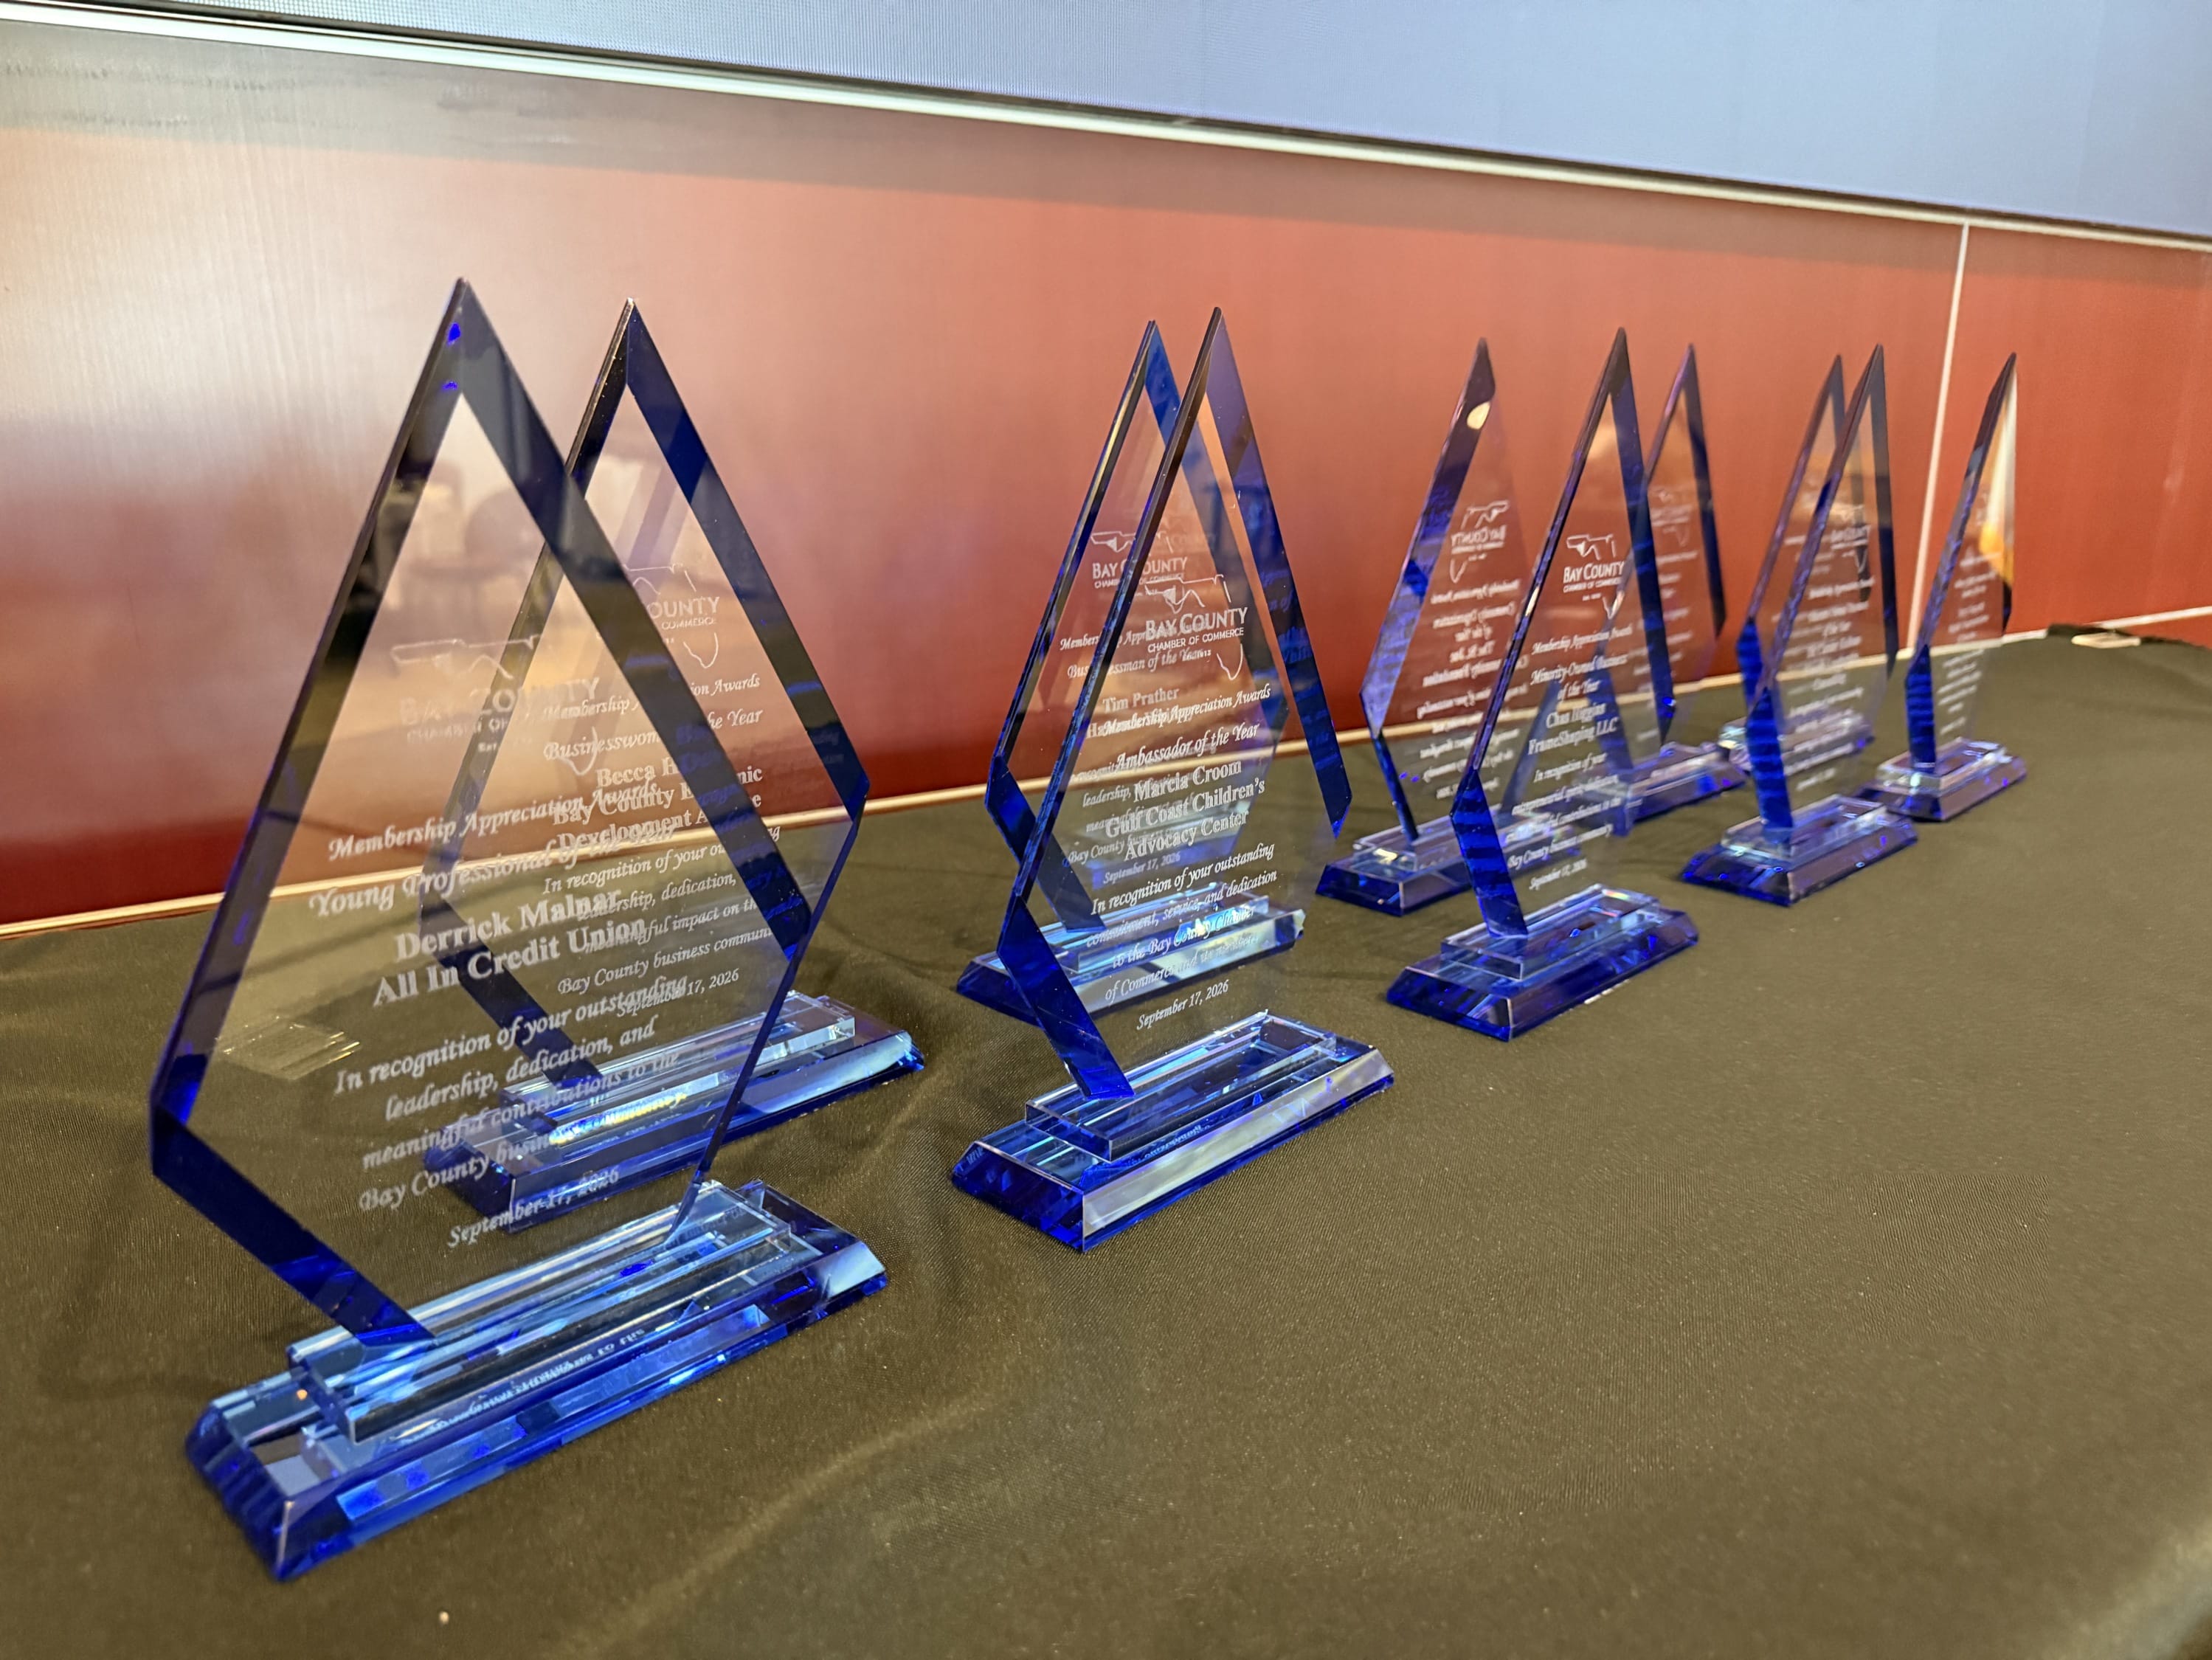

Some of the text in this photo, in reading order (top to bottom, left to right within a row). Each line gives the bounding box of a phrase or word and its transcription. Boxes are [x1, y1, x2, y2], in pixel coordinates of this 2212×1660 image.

[1092, 562, 1119, 579] BAY
[1563, 561, 1625, 584] BAY COUNTY
[646, 596, 720, 620] OUNTY
[1145, 618, 1178, 640] BAY
[1179, 607, 1248, 634] COUNTY
[1060, 631, 1122, 651] Membersp
[1147, 627, 1245, 653] CHAMBER OF COMMERCE
[1067, 658, 1146, 679] Busessman
[1147, 651, 1160, 672] of
[1161, 649, 1178, 665] the
[543, 695, 630, 720] Membership
[711, 674, 761, 696] Awards
[1102, 688, 1181, 713] Tim Prather
[1168, 695, 1233, 724] Appreciation
[1233, 683, 1271, 708] Awards
[544, 708, 763, 761] Businesswom he Year
[1115, 722, 1261, 771] Ambassador of the Year
[595, 764, 656, 788] Becca
[1133, 772, 1189, 803] Marcia
[1192, 761, 1242, 786] Croom
[553, 803, 592, 826] Bay
[598, 787, 674, 816] County
[1082, 785, 1131, 808] leadership,
[328, 817, 456, 861] Membership
[460, 795, 584, 837] Appreciation
[557, 810, 692, 848] Development
[1106, 809, 1146, 838] Gulf
[1145, 800, 1189, 826] Coast
[1124, 826, 1197, 862] Advocacy
[1200, 809, 1250, 837] Center
[543, 845, 708, 895] In recognition of your
[1069, 838, 1125, 865] Bay County
[309, 883, 395, 916] Young
[402, 840, 556, 899] Professional
[661, 874, 736, 901] dedication,
[1091, 842, 1275, 916] In recognition of your outstanding
[1104, 862, 1146, 885] September
[1147, 858, 1159, 870] 17,
[1204, 888, 1224, 904] and
[1225, 870, 1277, 898] dedication
[395, 890, 621, 961] Derrick Malnar
[673, 907, 720, 932] impact
[723, 902, 741, 916] on
[744, 896, 758, 912] th
[373, 919, 646, 1006] All In Credit Union
[1149, 936, 1172, 957] Bay
[558, 975, 591, 995] Bay
[594, 958, 649, 987] County
[653, 941, 711, 969] business
[686, 978, 705, 997] 17,
[709, 968, 740, 989] 2026
[1105, 981, 1120, 1000] of
[1136, 979, 1229, 1031] September 17, 2026
[334, 975, 688, 1095] In recognition of your outstanding
[385, 1014, 658, 1121] leadership, dedication, and
[363, 1107, 490, 1169] meaningful
[491, 1072, 621, 1127] contributions
[359, 1183, 406, 1212] Bay
[412, 1155, 489, 1196] County
[447, 1197, 539, 1248] September
